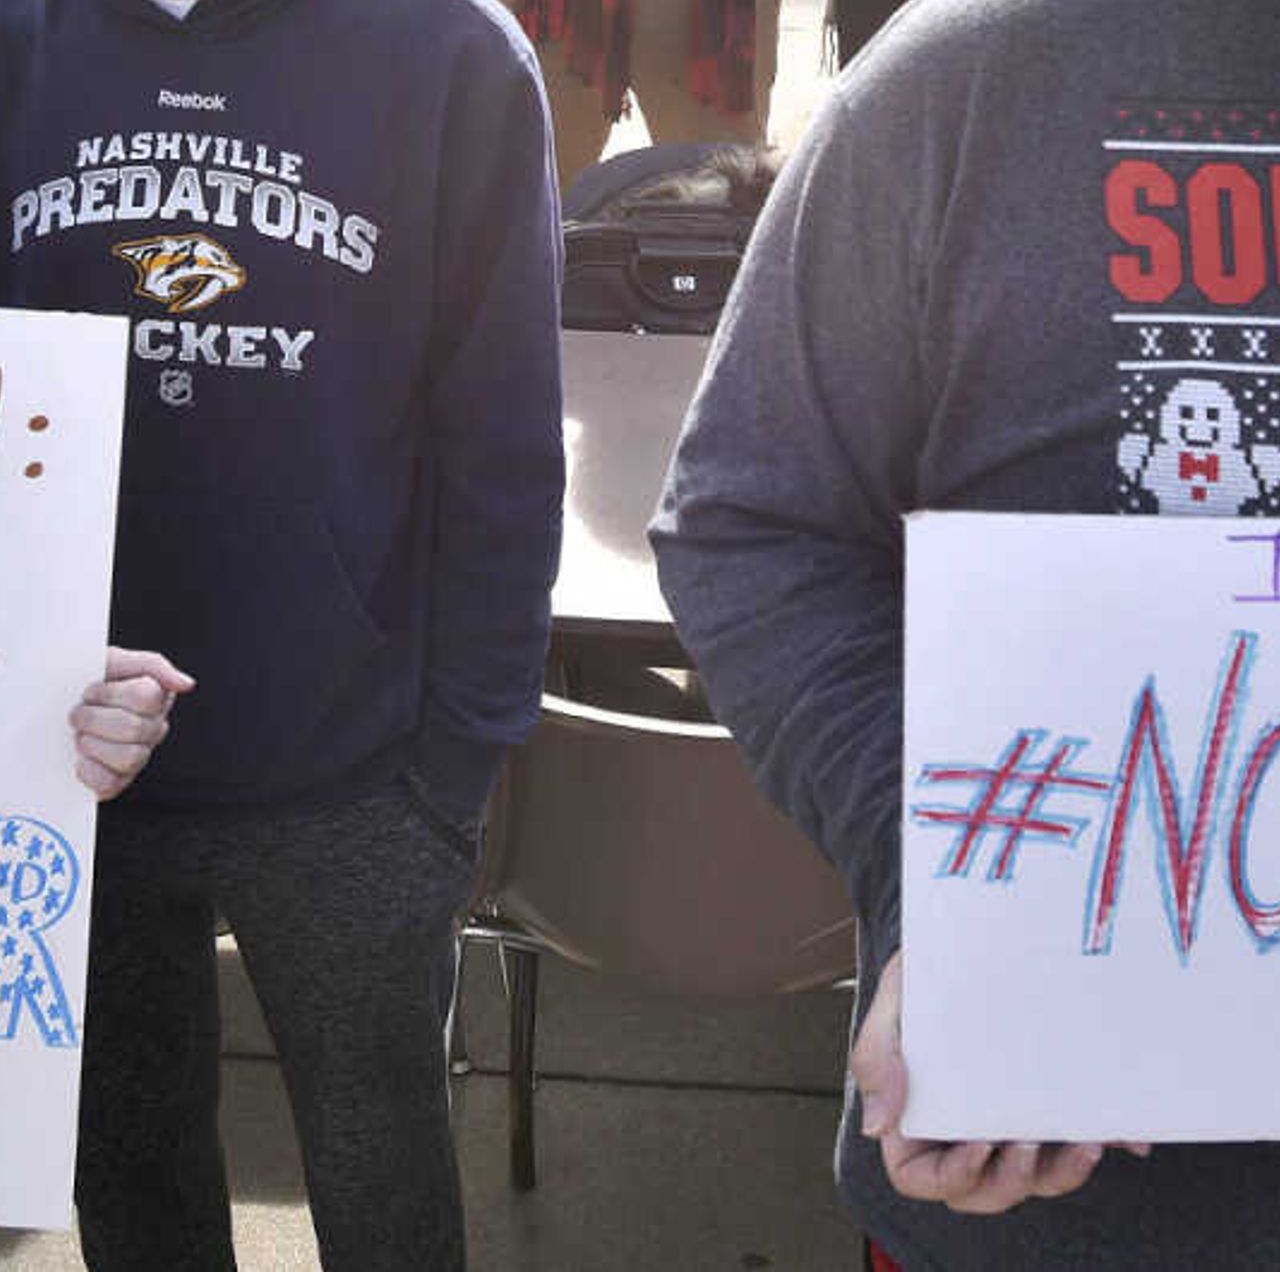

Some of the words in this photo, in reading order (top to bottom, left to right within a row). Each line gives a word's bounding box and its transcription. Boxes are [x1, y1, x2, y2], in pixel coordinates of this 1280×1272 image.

[158, 89, 226, 110] Reebok
[75, 130, 303, 183] NASHVILLE
[10, 165, 380, 274] PREDATORS
[134, 318, 315, 371] CKEY
